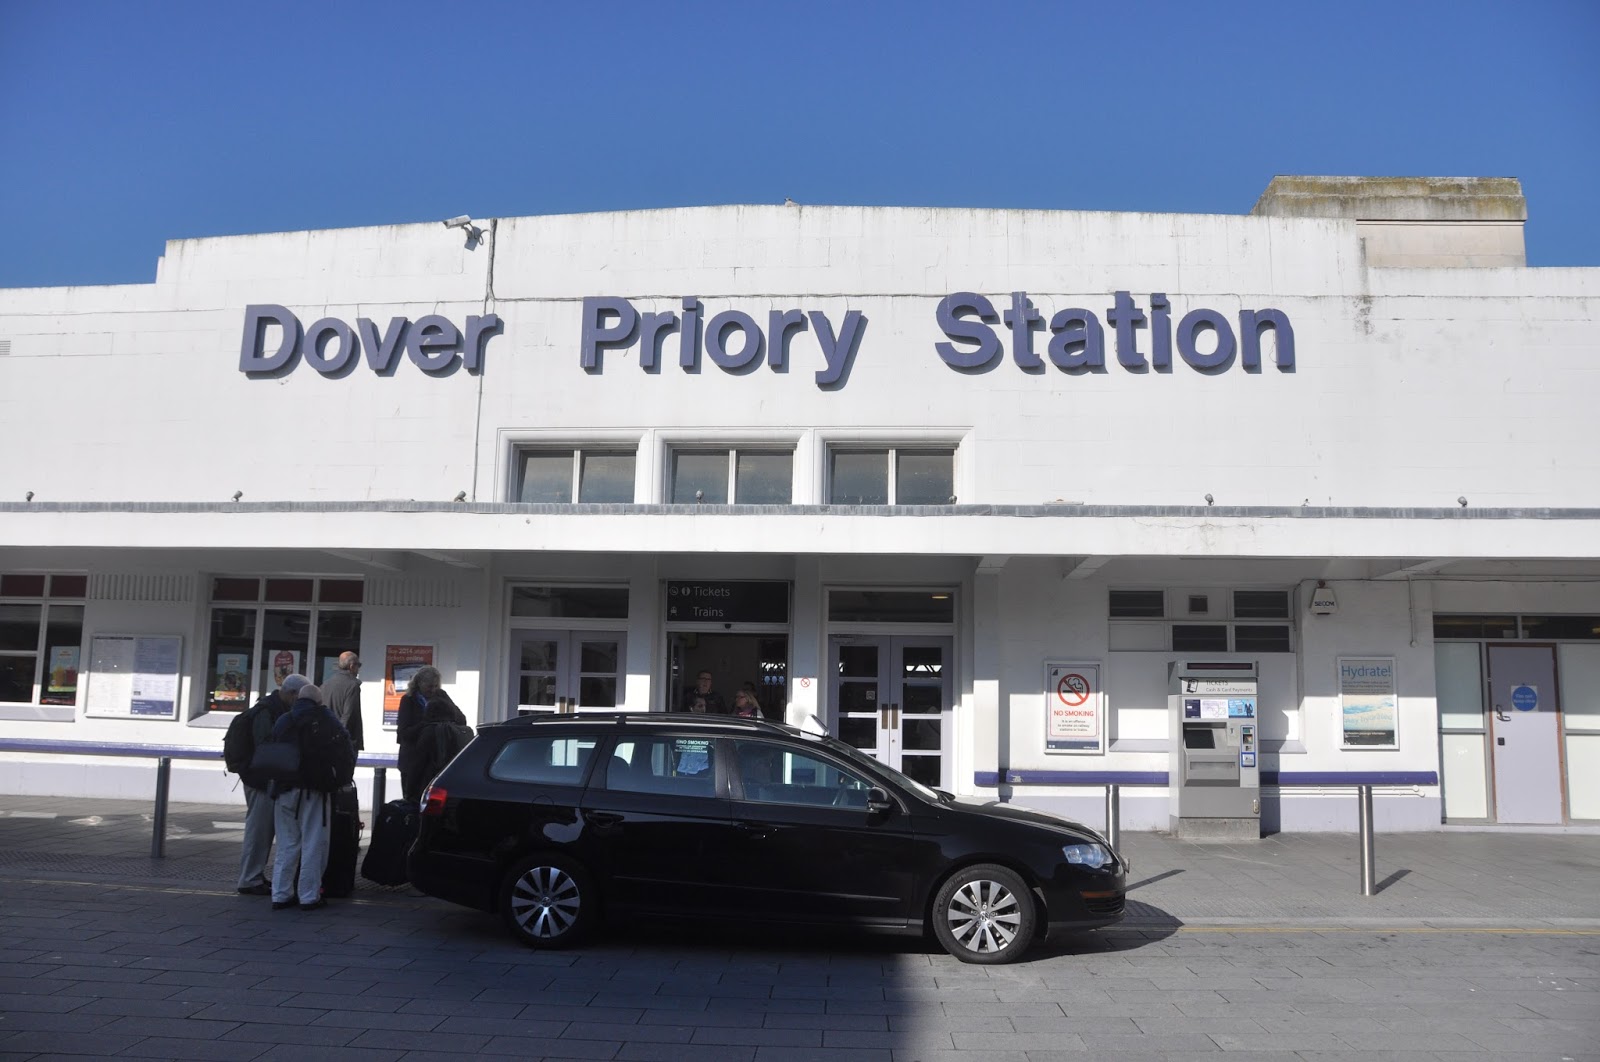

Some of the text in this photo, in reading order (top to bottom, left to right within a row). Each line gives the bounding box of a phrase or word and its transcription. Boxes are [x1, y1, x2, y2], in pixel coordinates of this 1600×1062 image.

[239, 290, 1296, 391] Dover Priory Station
[693, 586, 730, 597] Tickets
[693, 606, 724, 617] Trains
[1341, 665, 1391, 679] Hydrate!
